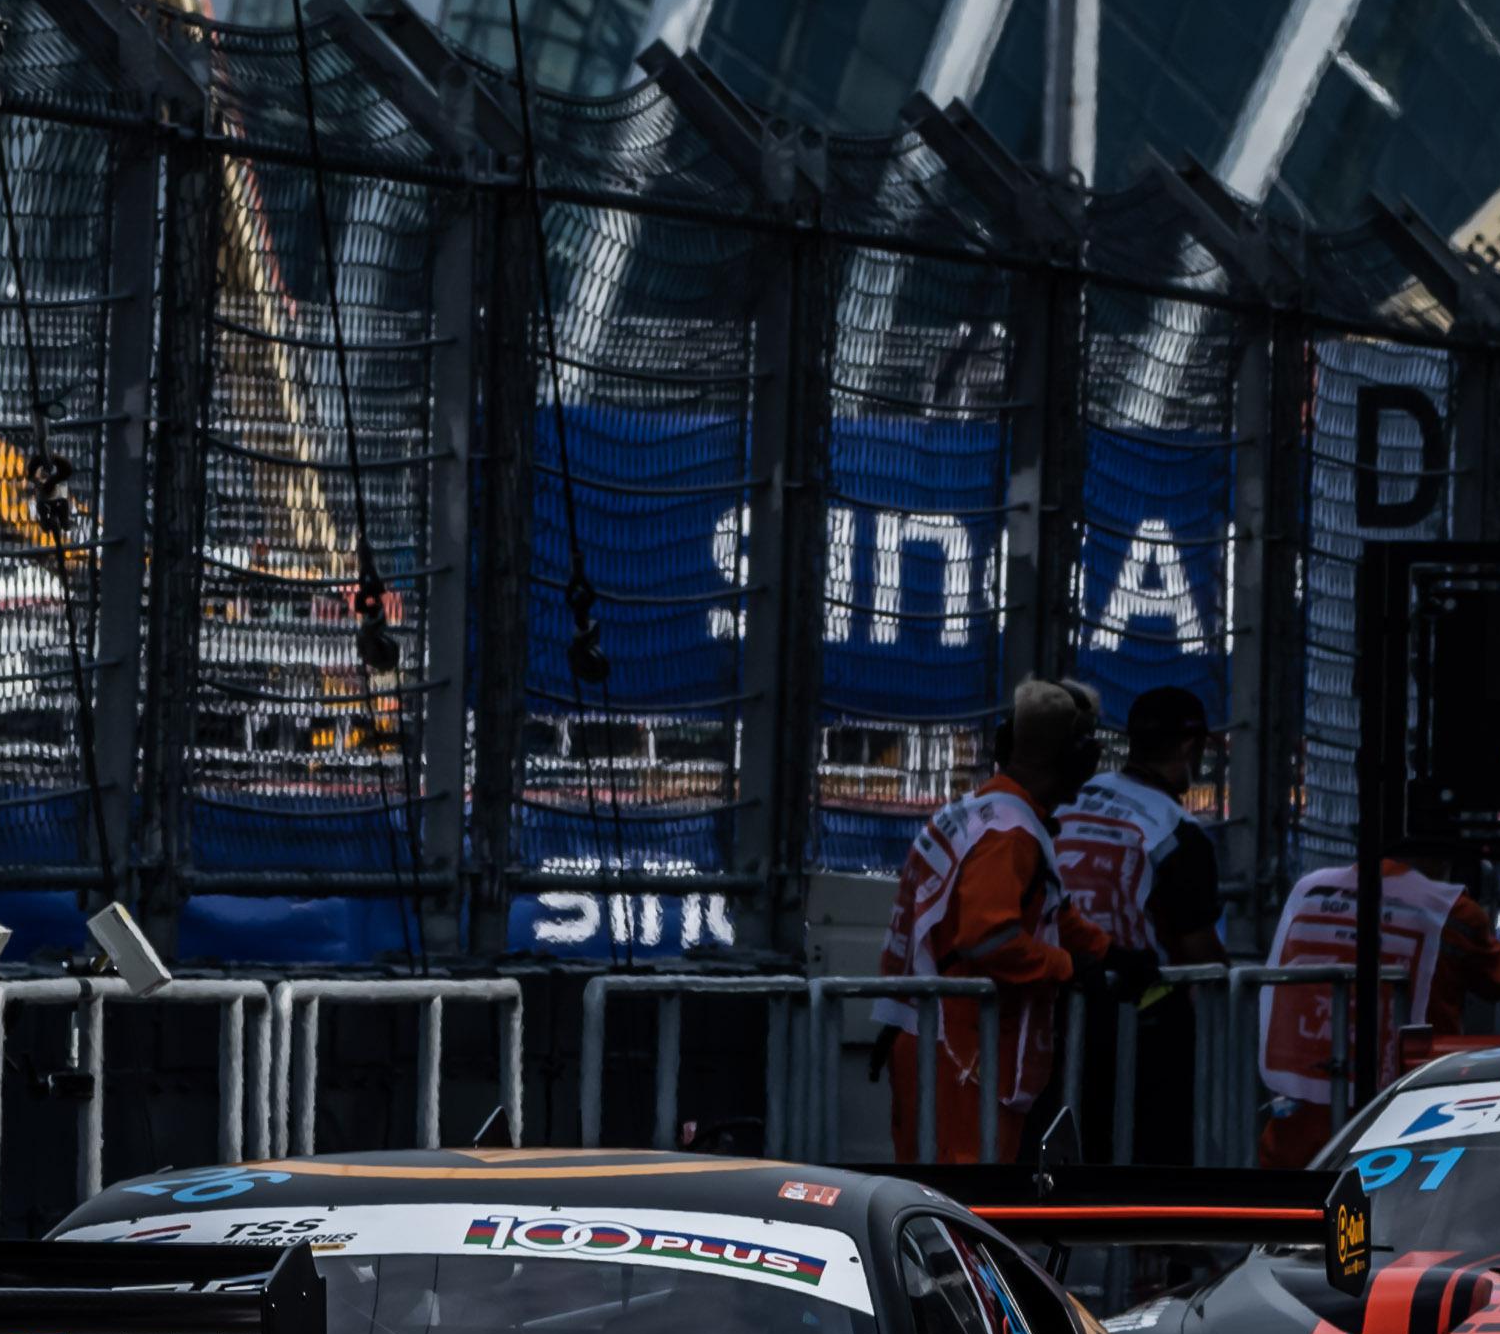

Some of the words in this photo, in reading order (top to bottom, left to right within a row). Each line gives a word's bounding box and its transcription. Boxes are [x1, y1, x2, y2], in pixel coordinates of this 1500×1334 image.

[1354, 1146, 1467, 1193] 91
[223, 1217, 329, 1240] TSS
[488, 1214, 643, 1256] 100
[650, 1234, 800, 1274] PLUS
